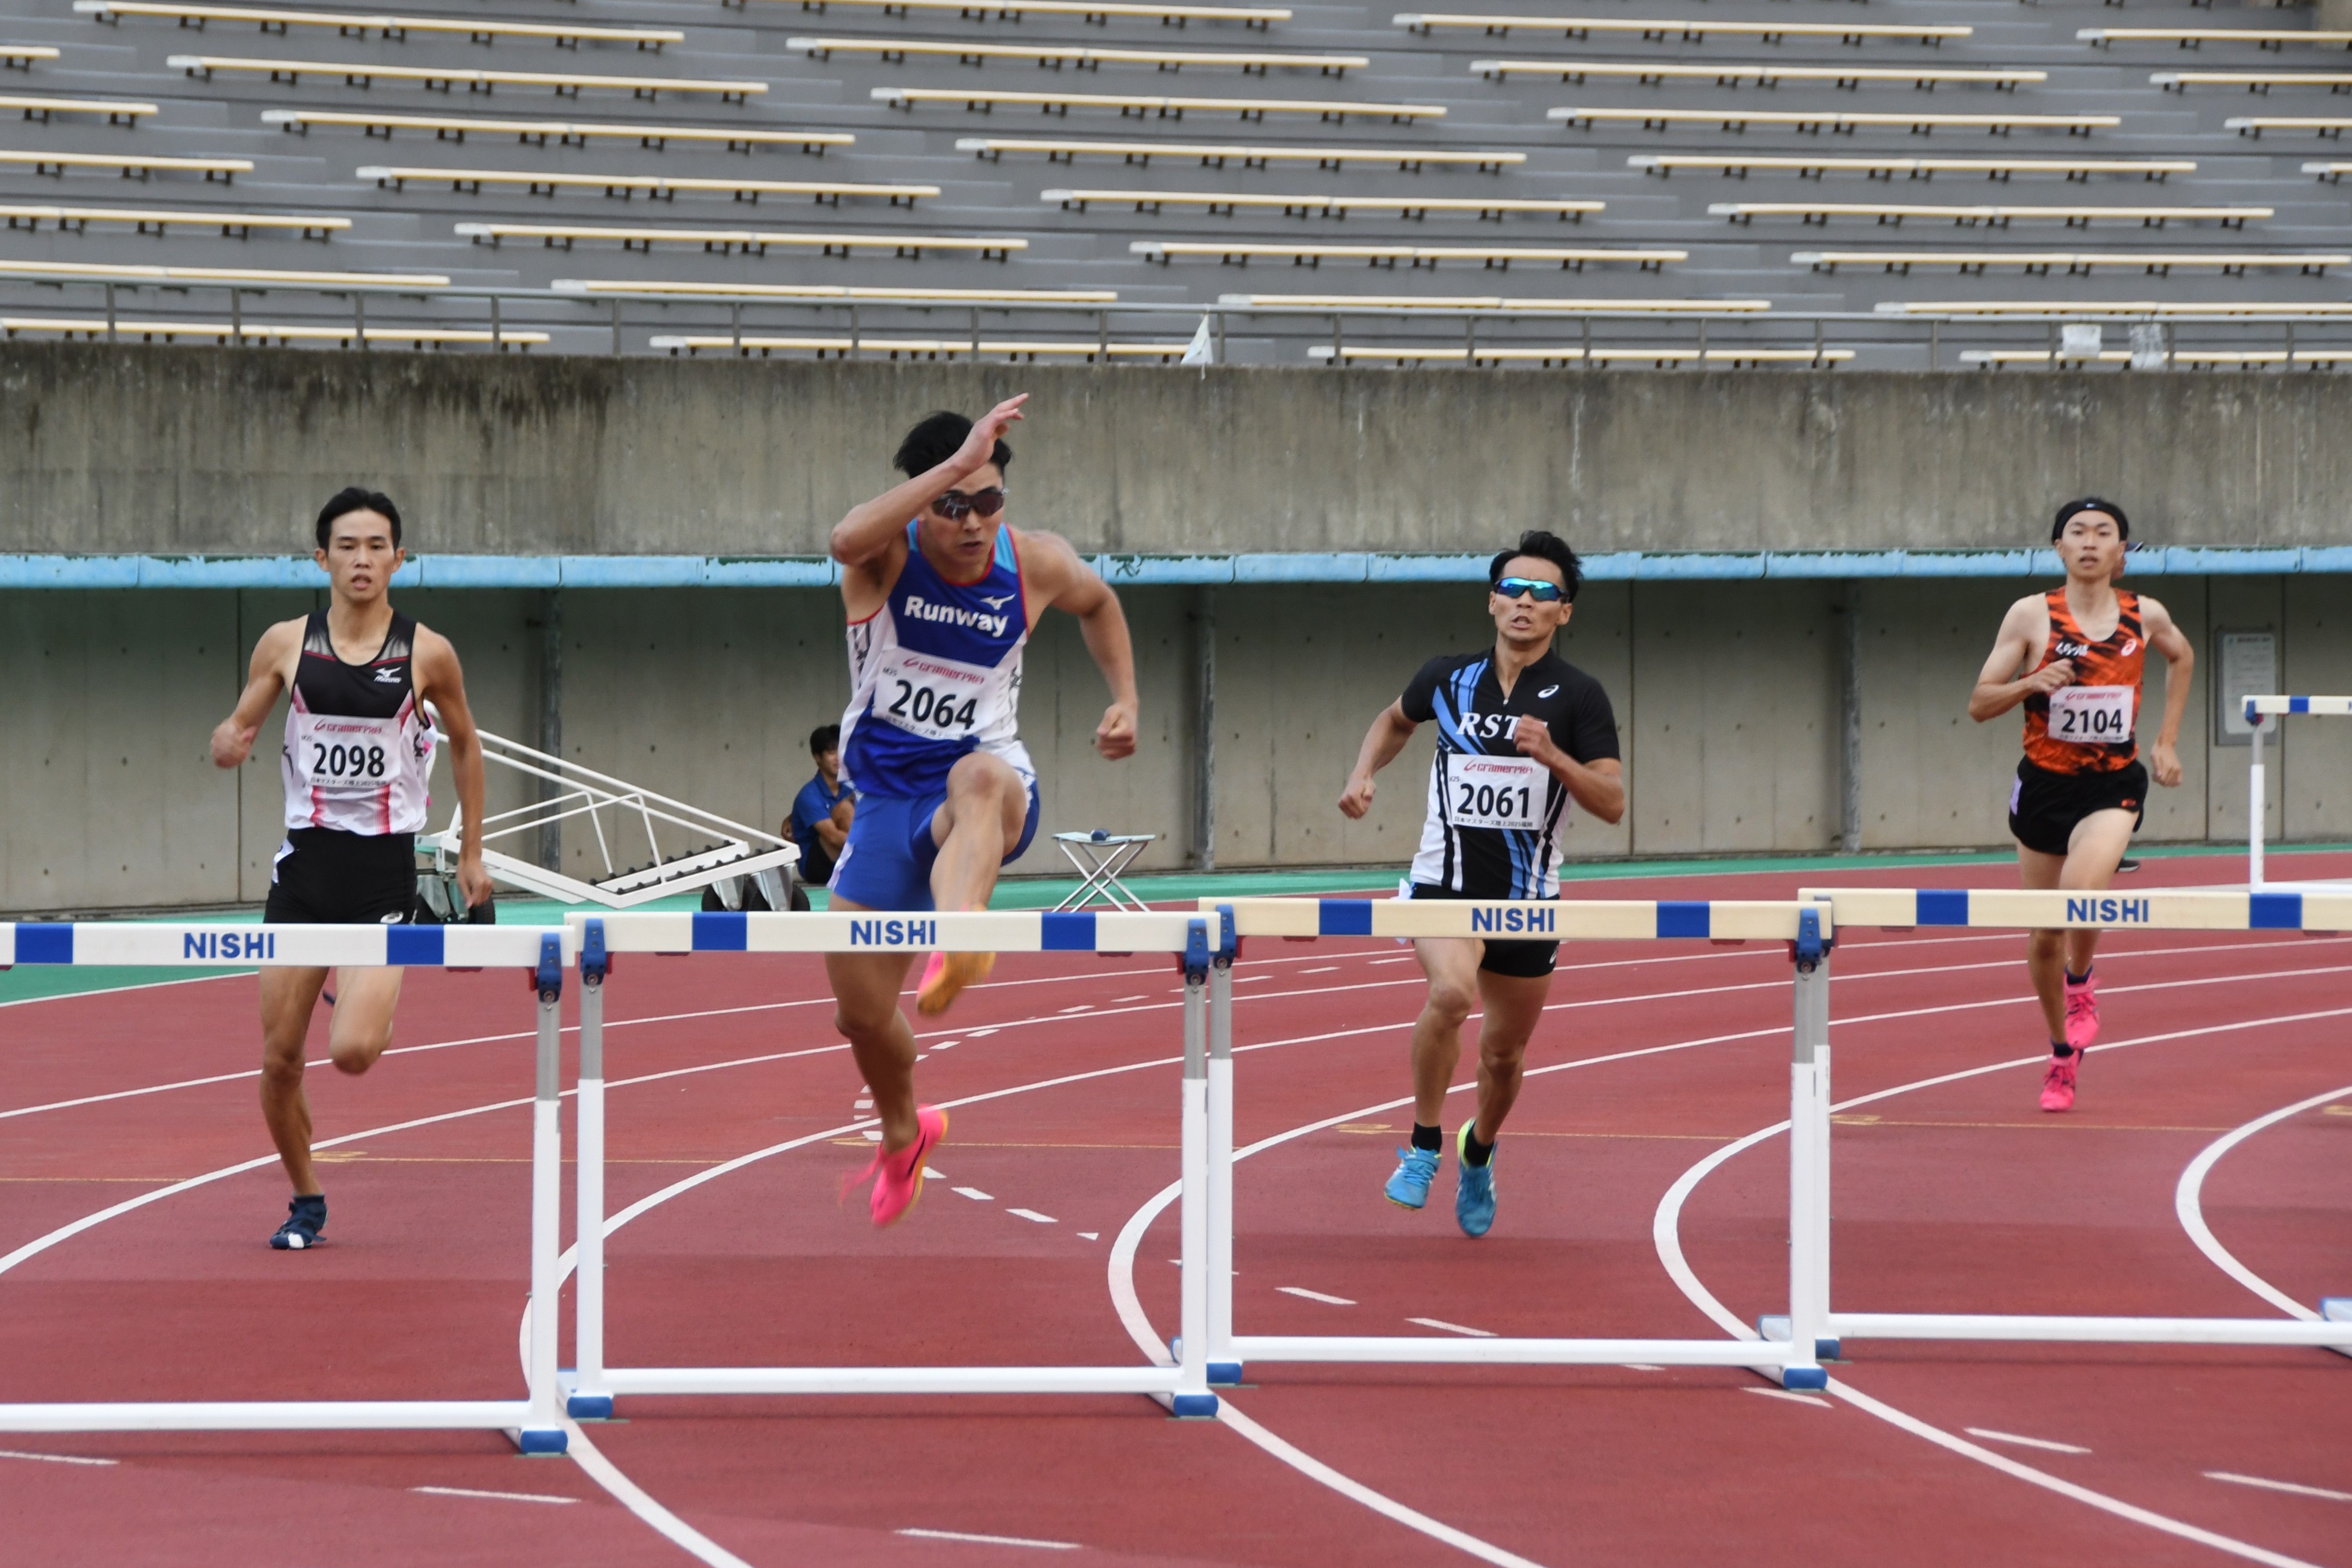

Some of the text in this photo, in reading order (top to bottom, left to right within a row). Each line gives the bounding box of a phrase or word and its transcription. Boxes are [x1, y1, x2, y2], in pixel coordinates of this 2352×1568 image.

[904, 595, 1009, 638] Runway
[888, 679, 978, 731] 2064
[1455, 712, 1548, 740] RST
[2061, 708, 2123, 734] 2104
[313, 743, 385, 778] 2098
[1457, 783, 1530, 819] 2061
[1472, 908, 1554, 932] NISHI
[2067, 899, 2148, 923] NISHI
[184, 932, 274, 959] NISHI
[851, 920, 936, 945] NISHI
